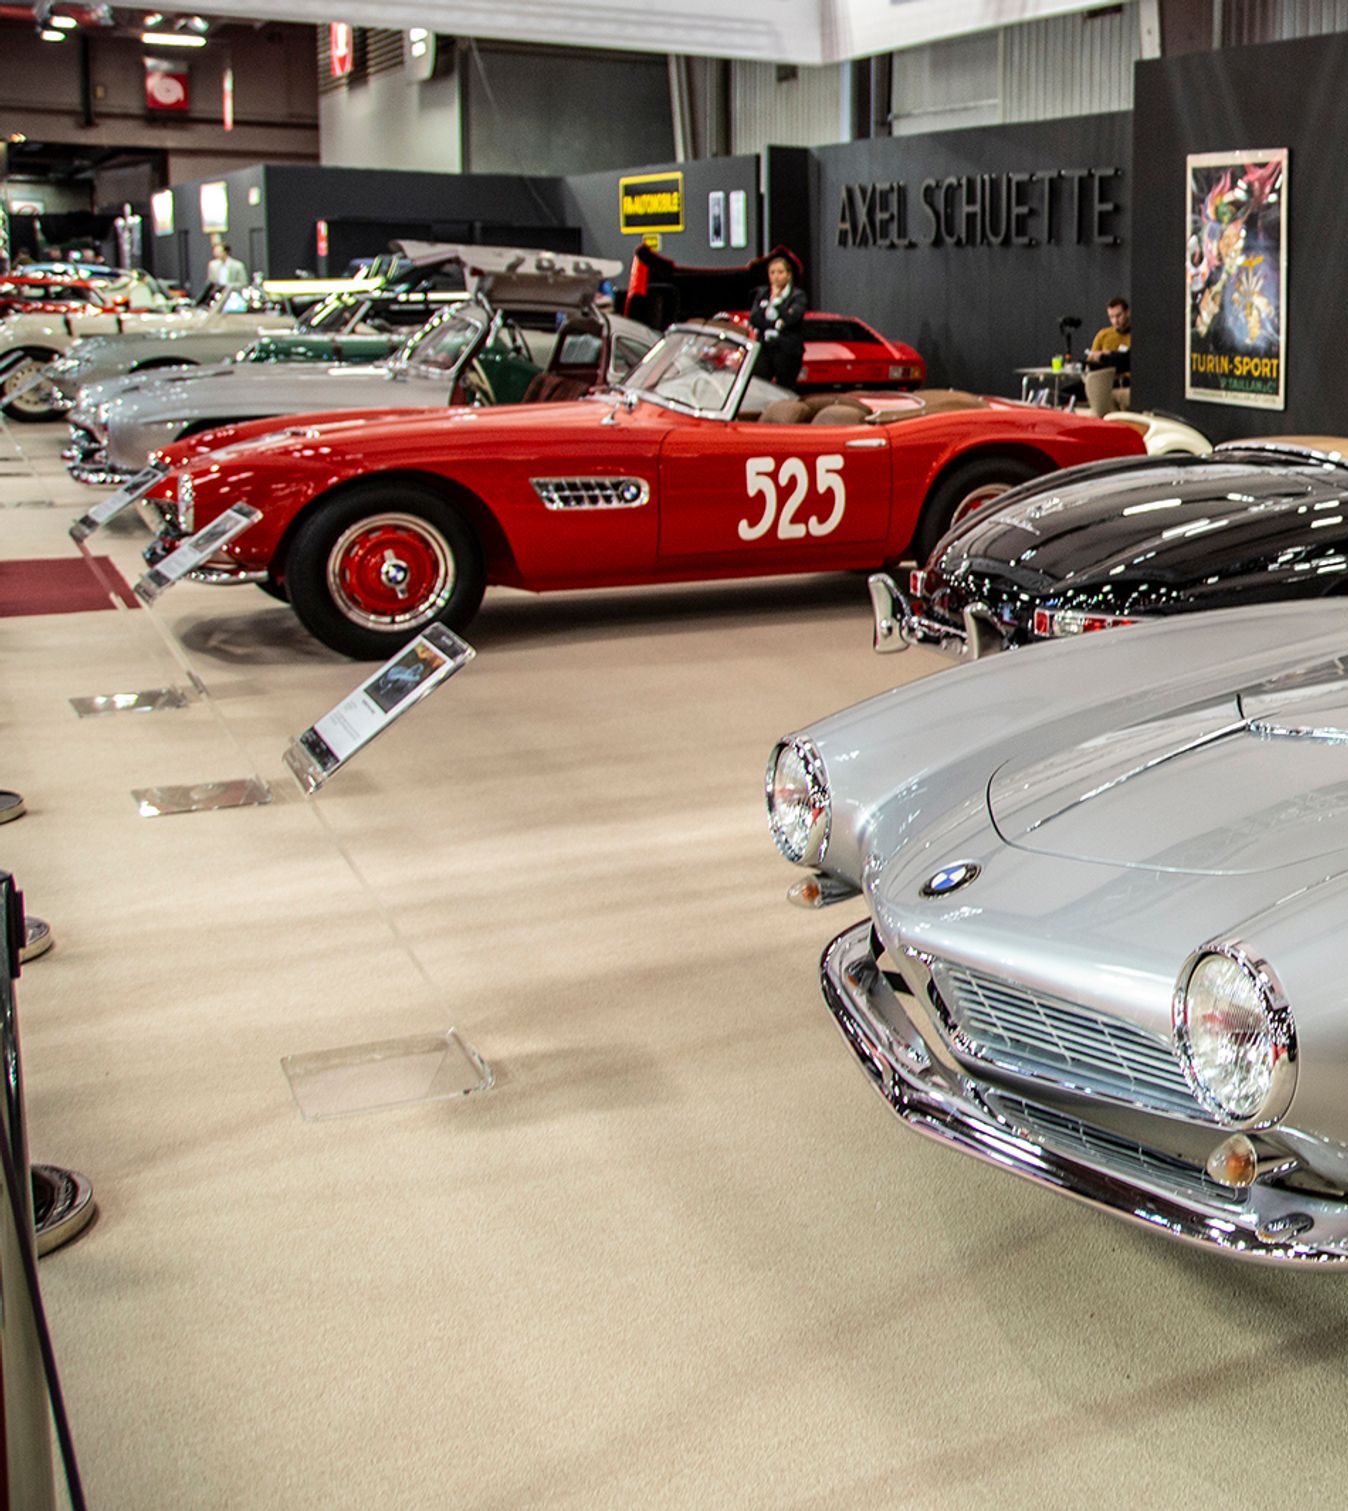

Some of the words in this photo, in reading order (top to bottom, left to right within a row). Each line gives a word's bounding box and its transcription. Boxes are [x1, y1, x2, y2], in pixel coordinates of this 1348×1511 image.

[835, 181, 914, 247] AXEL
[920, 168, 1120, 247] SCHUETTE
[1191, 352, 1279, 379] TURIN-SPORT
[738, 454, 846, 541] 525
